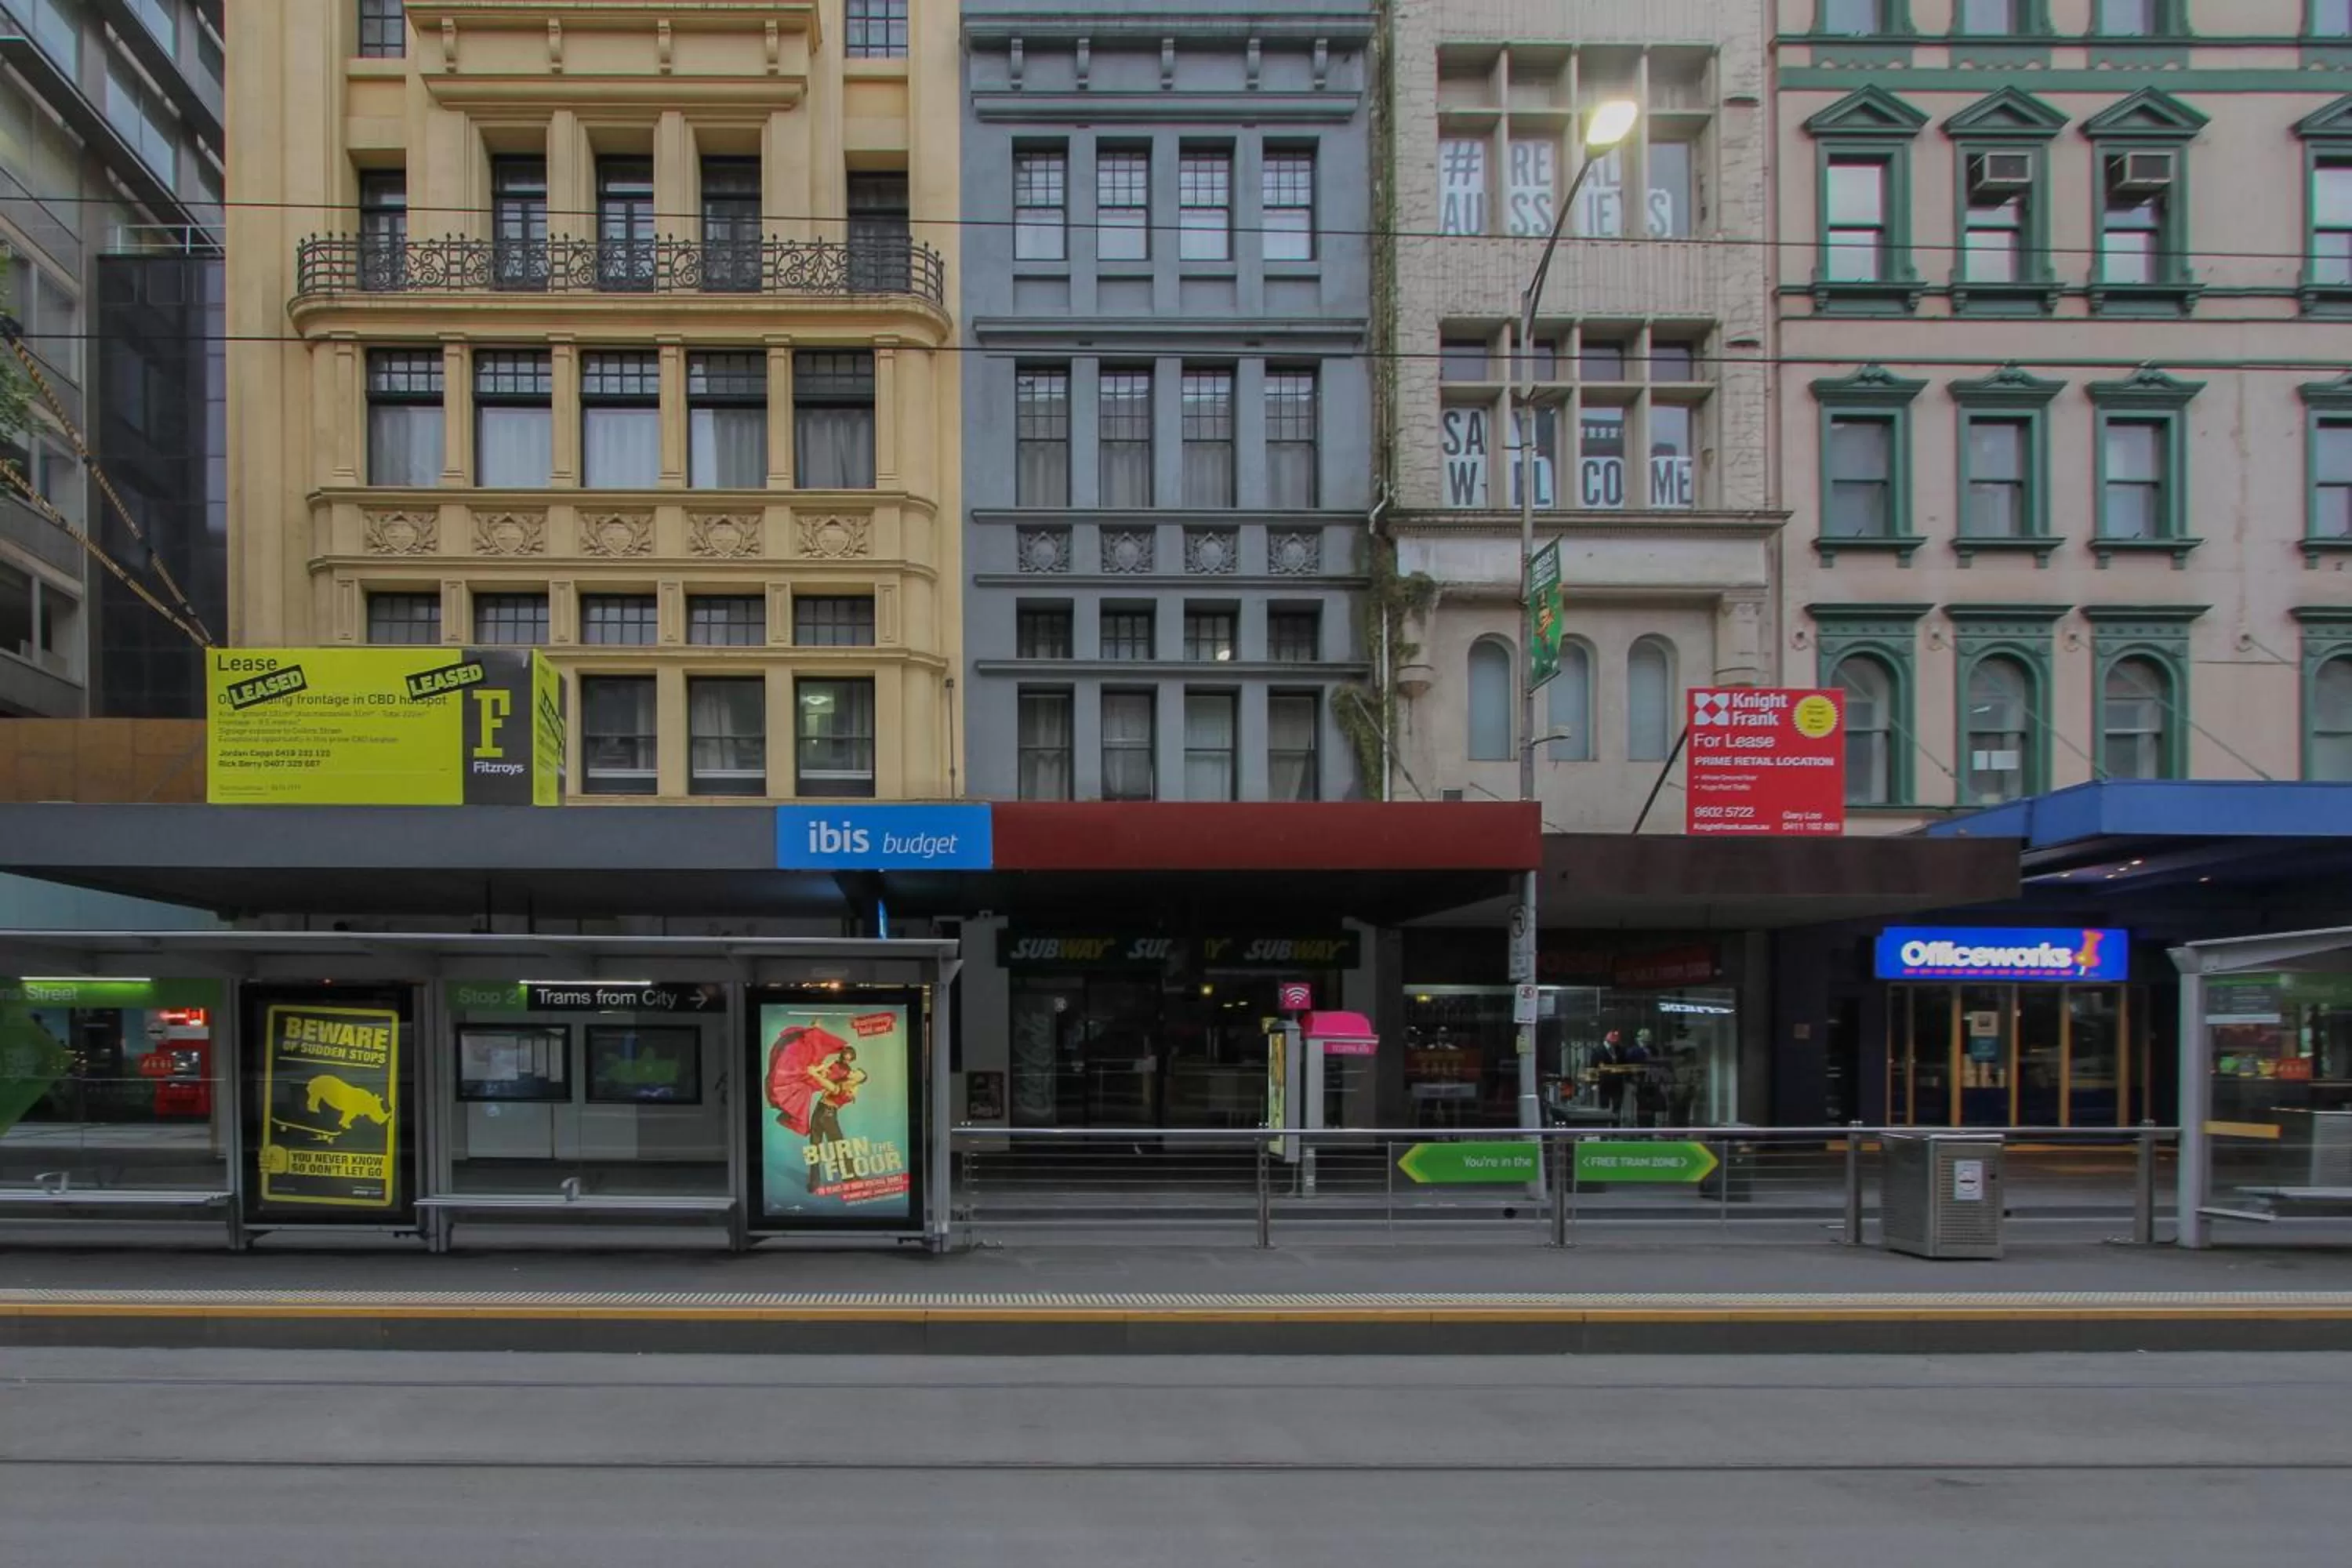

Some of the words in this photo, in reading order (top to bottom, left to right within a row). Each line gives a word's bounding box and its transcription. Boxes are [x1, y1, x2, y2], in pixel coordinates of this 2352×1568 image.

[217, 655, 277, 671] Lease
[230, 670, 303, 705] LEASED
[409, 664, 484, 696] LEASED
[297, 694, 350, 708] frontage
[354, 695, 364, 705] in
[368, 695, 395, 705] CBD
[1732, 693, 1788, 710] Knight
[473, 689, 510, 758] F
[1732, 711, 1780, 726] Frank
[1693, 733, 1720, 747] For
[1726, 733, 1776, 748] Lease
[473, 761, 525, 775] Fitzroys
[1694, 757, 1732, 766] PRIME
[1734, 757, 1773, 766] RETAIL
[1777, 757, 1835, 766] LOCATION
[1725, 807, 1755, 818] 5722
[808, 821, 870, 854] ibis
[882, 832, 959, 858] budget
[1009, 937, 1116, 960] SUBWAY
[1243, 938, 1348, 960] SUBWAY
[1900, 939, 2073, 968] Officeworks
[25, 985, 77, 1001] Street
[459, 989, 500, 1007] Stop
[536, 989, 591, 1004] Trams
[596, 989, 636, 1004] from
[643, 989, 677, 1008] City
[284, 1016, 390, 1051] BEWARE
[282, 1040, 296, 1052] OF
[300, 1042, 347, 1058] SUDDEN
[350, 1049, 387, 1065] STOPS
[802, 1136, 870, 1165] BURN
[872, 1141, 895, 1154] THE
[292, 1153, 312, 1163] YOU
[315, 1154, 348, 1165] NEVER
[351, 1156, 383, 1166] KNOW
[1463, 1156, 1498, 1167] You're
[1501, 1157, 1512, 1167] in
[1513, 1156, 1532, 1167] the
[1591, 1157, 1617, 1167] FREE
[1621, 1157, 1651, 1167] TRAM
[1653, 1157, 1679, 1167] ZONE
[291, 1163, 306, 1173] SO
[309, 1163, 341, 1174] DON'T
[345, 1165, 365, 1176] LET
[368, 1166, 383, 1177] GO
